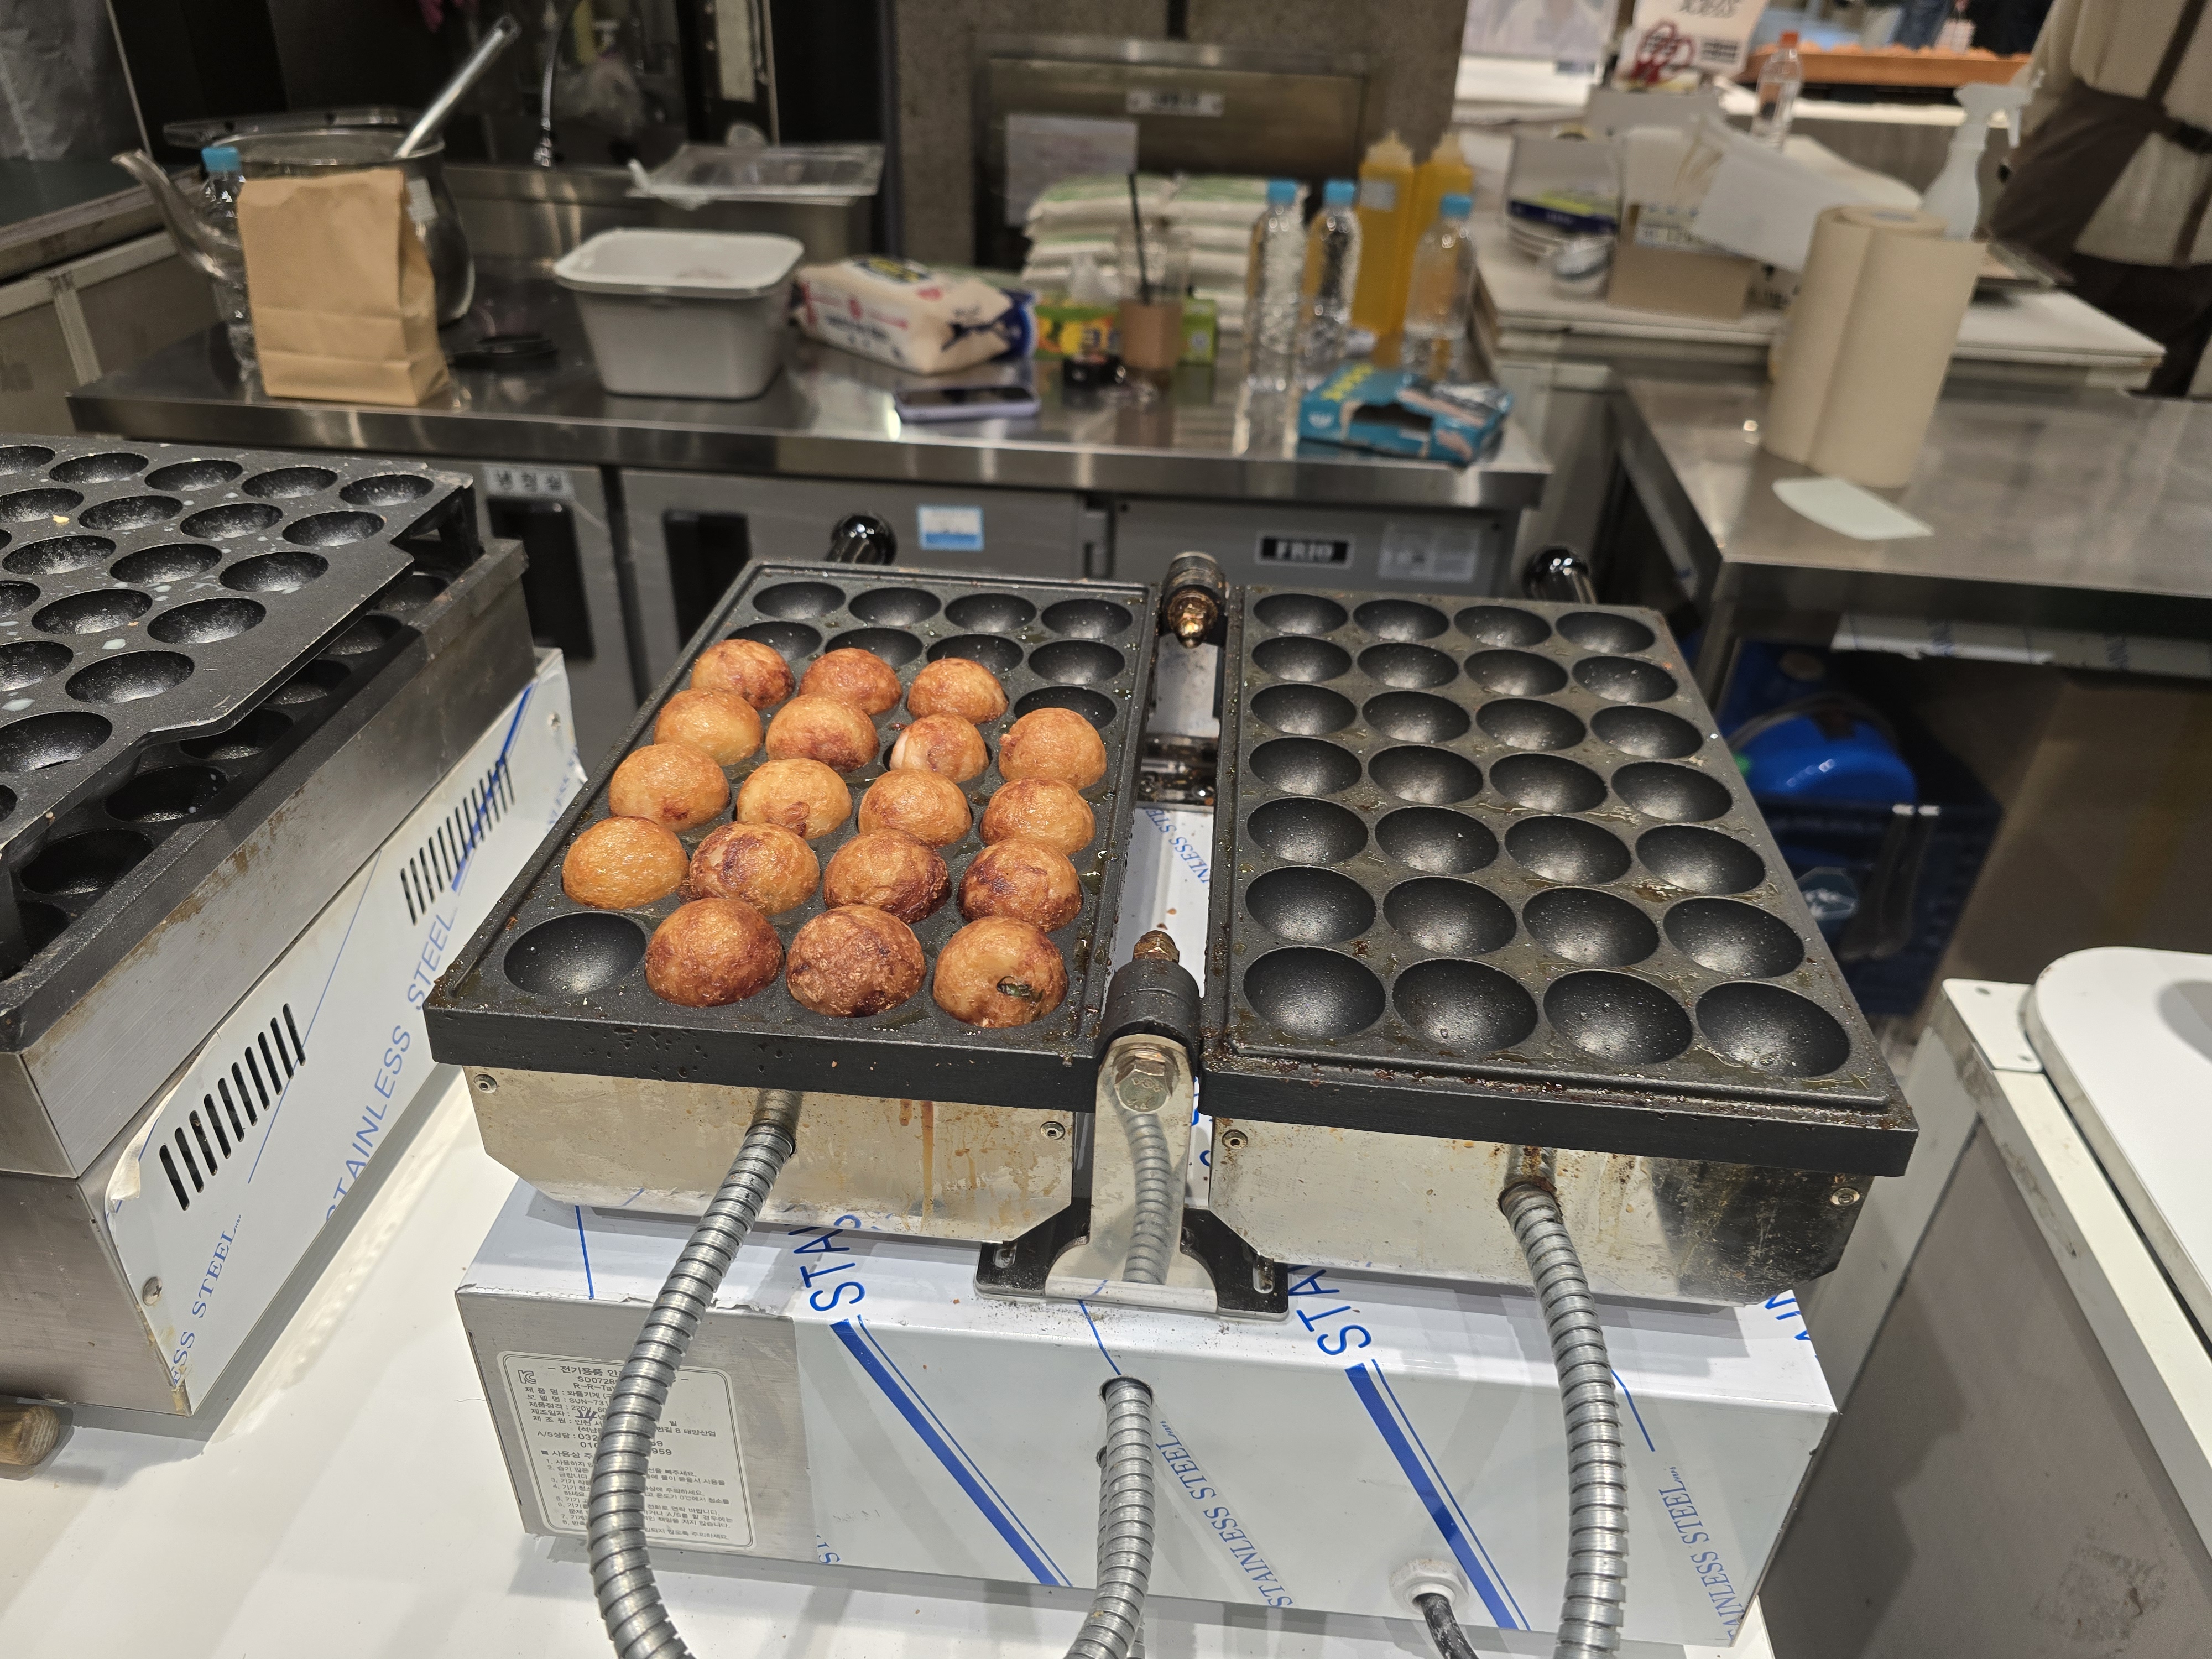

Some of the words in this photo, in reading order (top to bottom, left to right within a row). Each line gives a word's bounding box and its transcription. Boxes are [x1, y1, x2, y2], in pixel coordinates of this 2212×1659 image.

[407, 914, 455, 1011] STEEL
[192, 1227, 237, 1319] STEEL
[560, 1365, 604, 1376] 전기용품
[577, 1376, 617, 1385] SD0728
[529, 1401, 563, 1410] 제품정격
[531, 1408, 565, 1417] 제조일자
[551, 1450, 581, 1458] 사용상
[1155, 1434, 1217, 1500] STEEL
[1658, 1479, 1710, 1545] STEEL
[1203, 1506, 1293, 1608] STAINLESS
